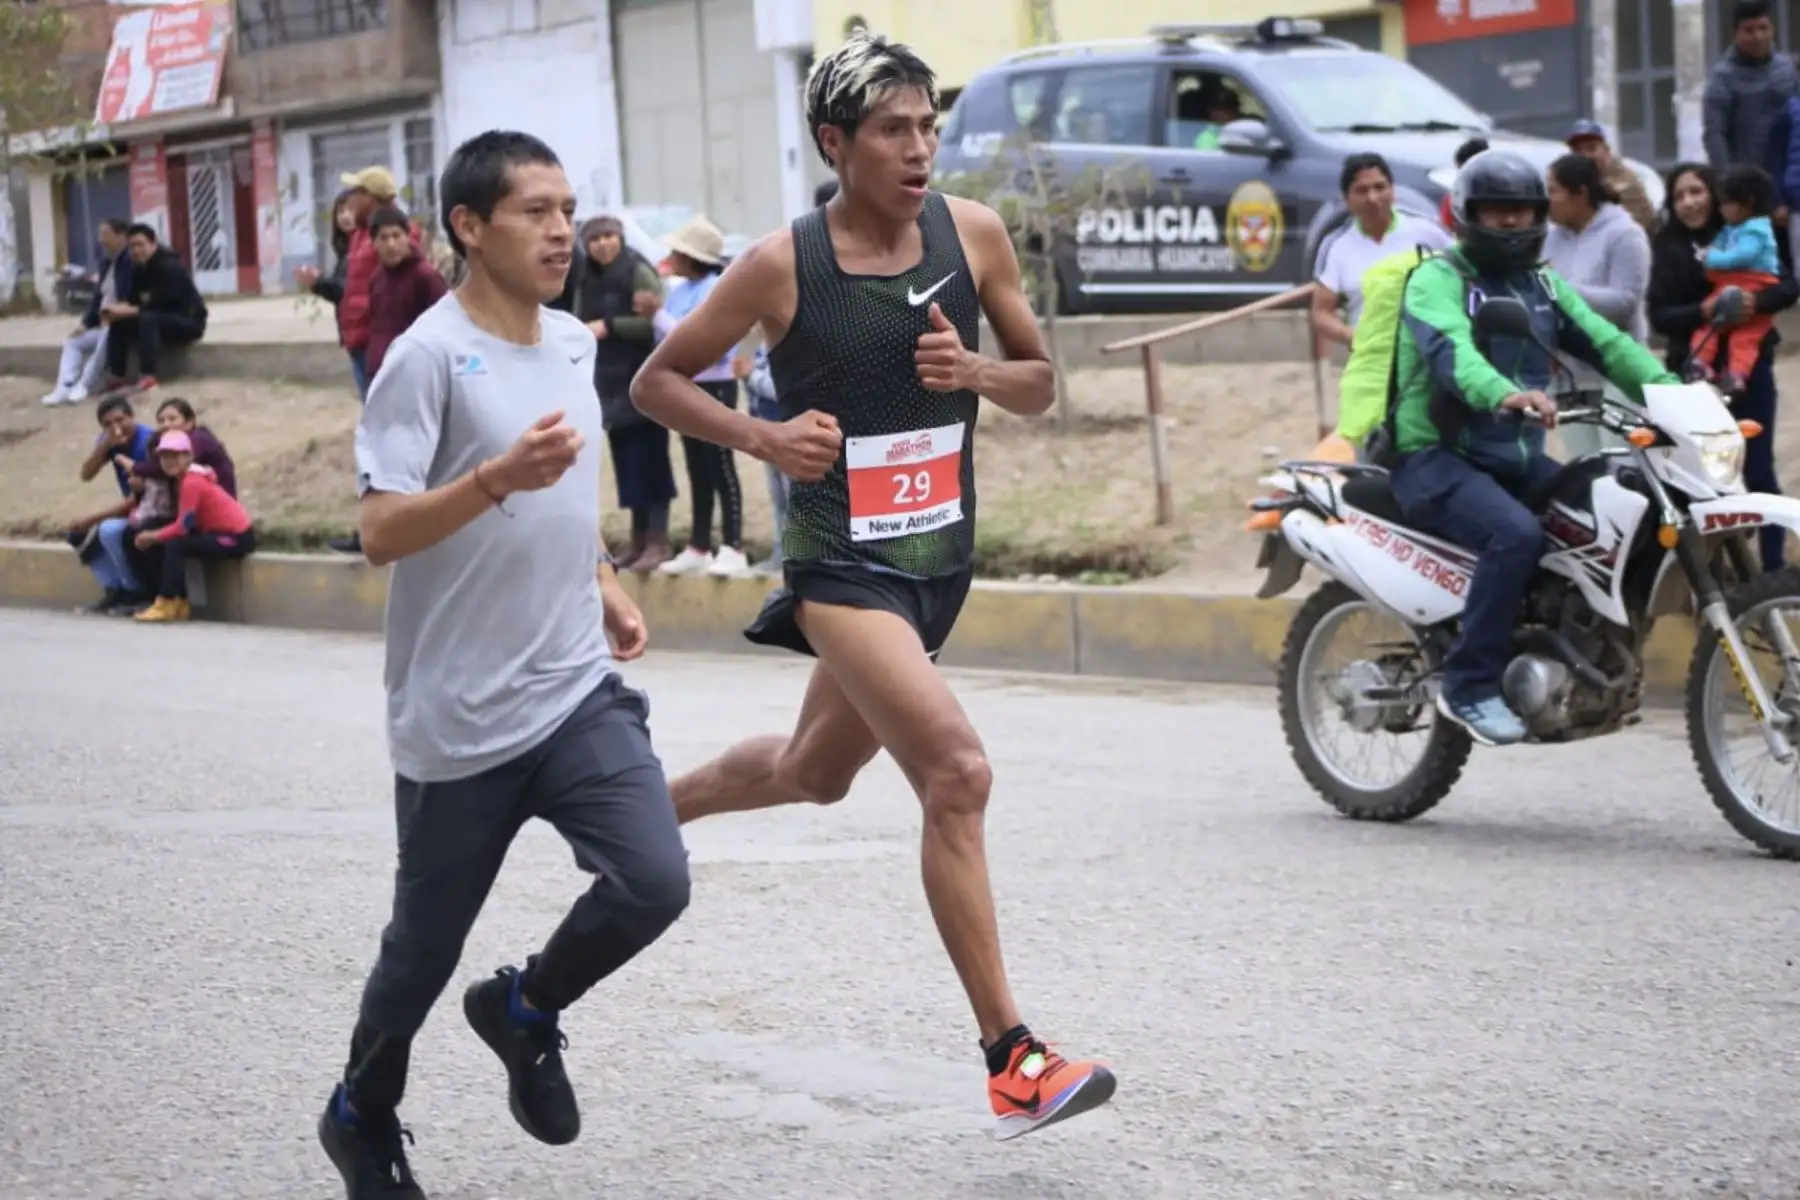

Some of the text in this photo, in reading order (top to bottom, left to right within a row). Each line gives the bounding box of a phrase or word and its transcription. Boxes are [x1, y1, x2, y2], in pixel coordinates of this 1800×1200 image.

[1076, 206, 1219, 243] POLICIA
[892, 471, 931, 504] 29
[869, 509, 950, 533] New Athletic
[1412, 552, 1466, 596] VENGO
